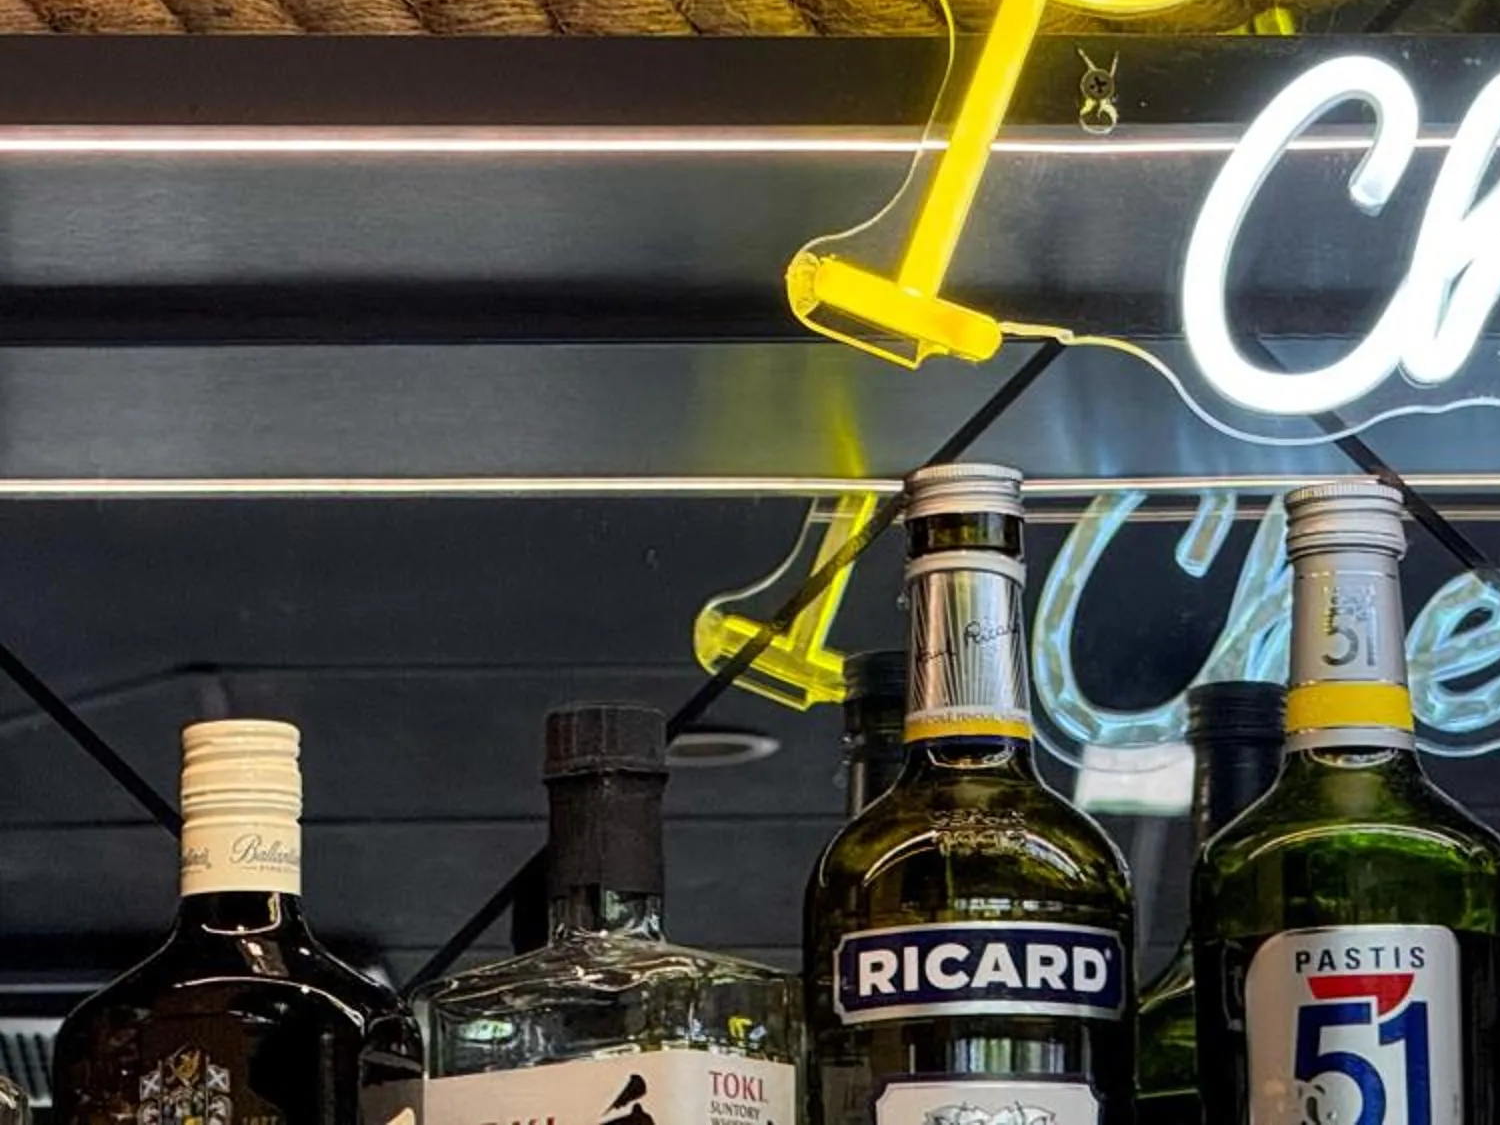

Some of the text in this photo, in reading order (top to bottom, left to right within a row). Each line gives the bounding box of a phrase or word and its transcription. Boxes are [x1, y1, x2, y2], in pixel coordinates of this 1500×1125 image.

[859, 942, 1107, 997] RICARD
[1295, 946, 1425, 973] PASTIS
[1294, 1001, 1433, 1125] 51
[708, 1070, 764, 1102] TOKI
